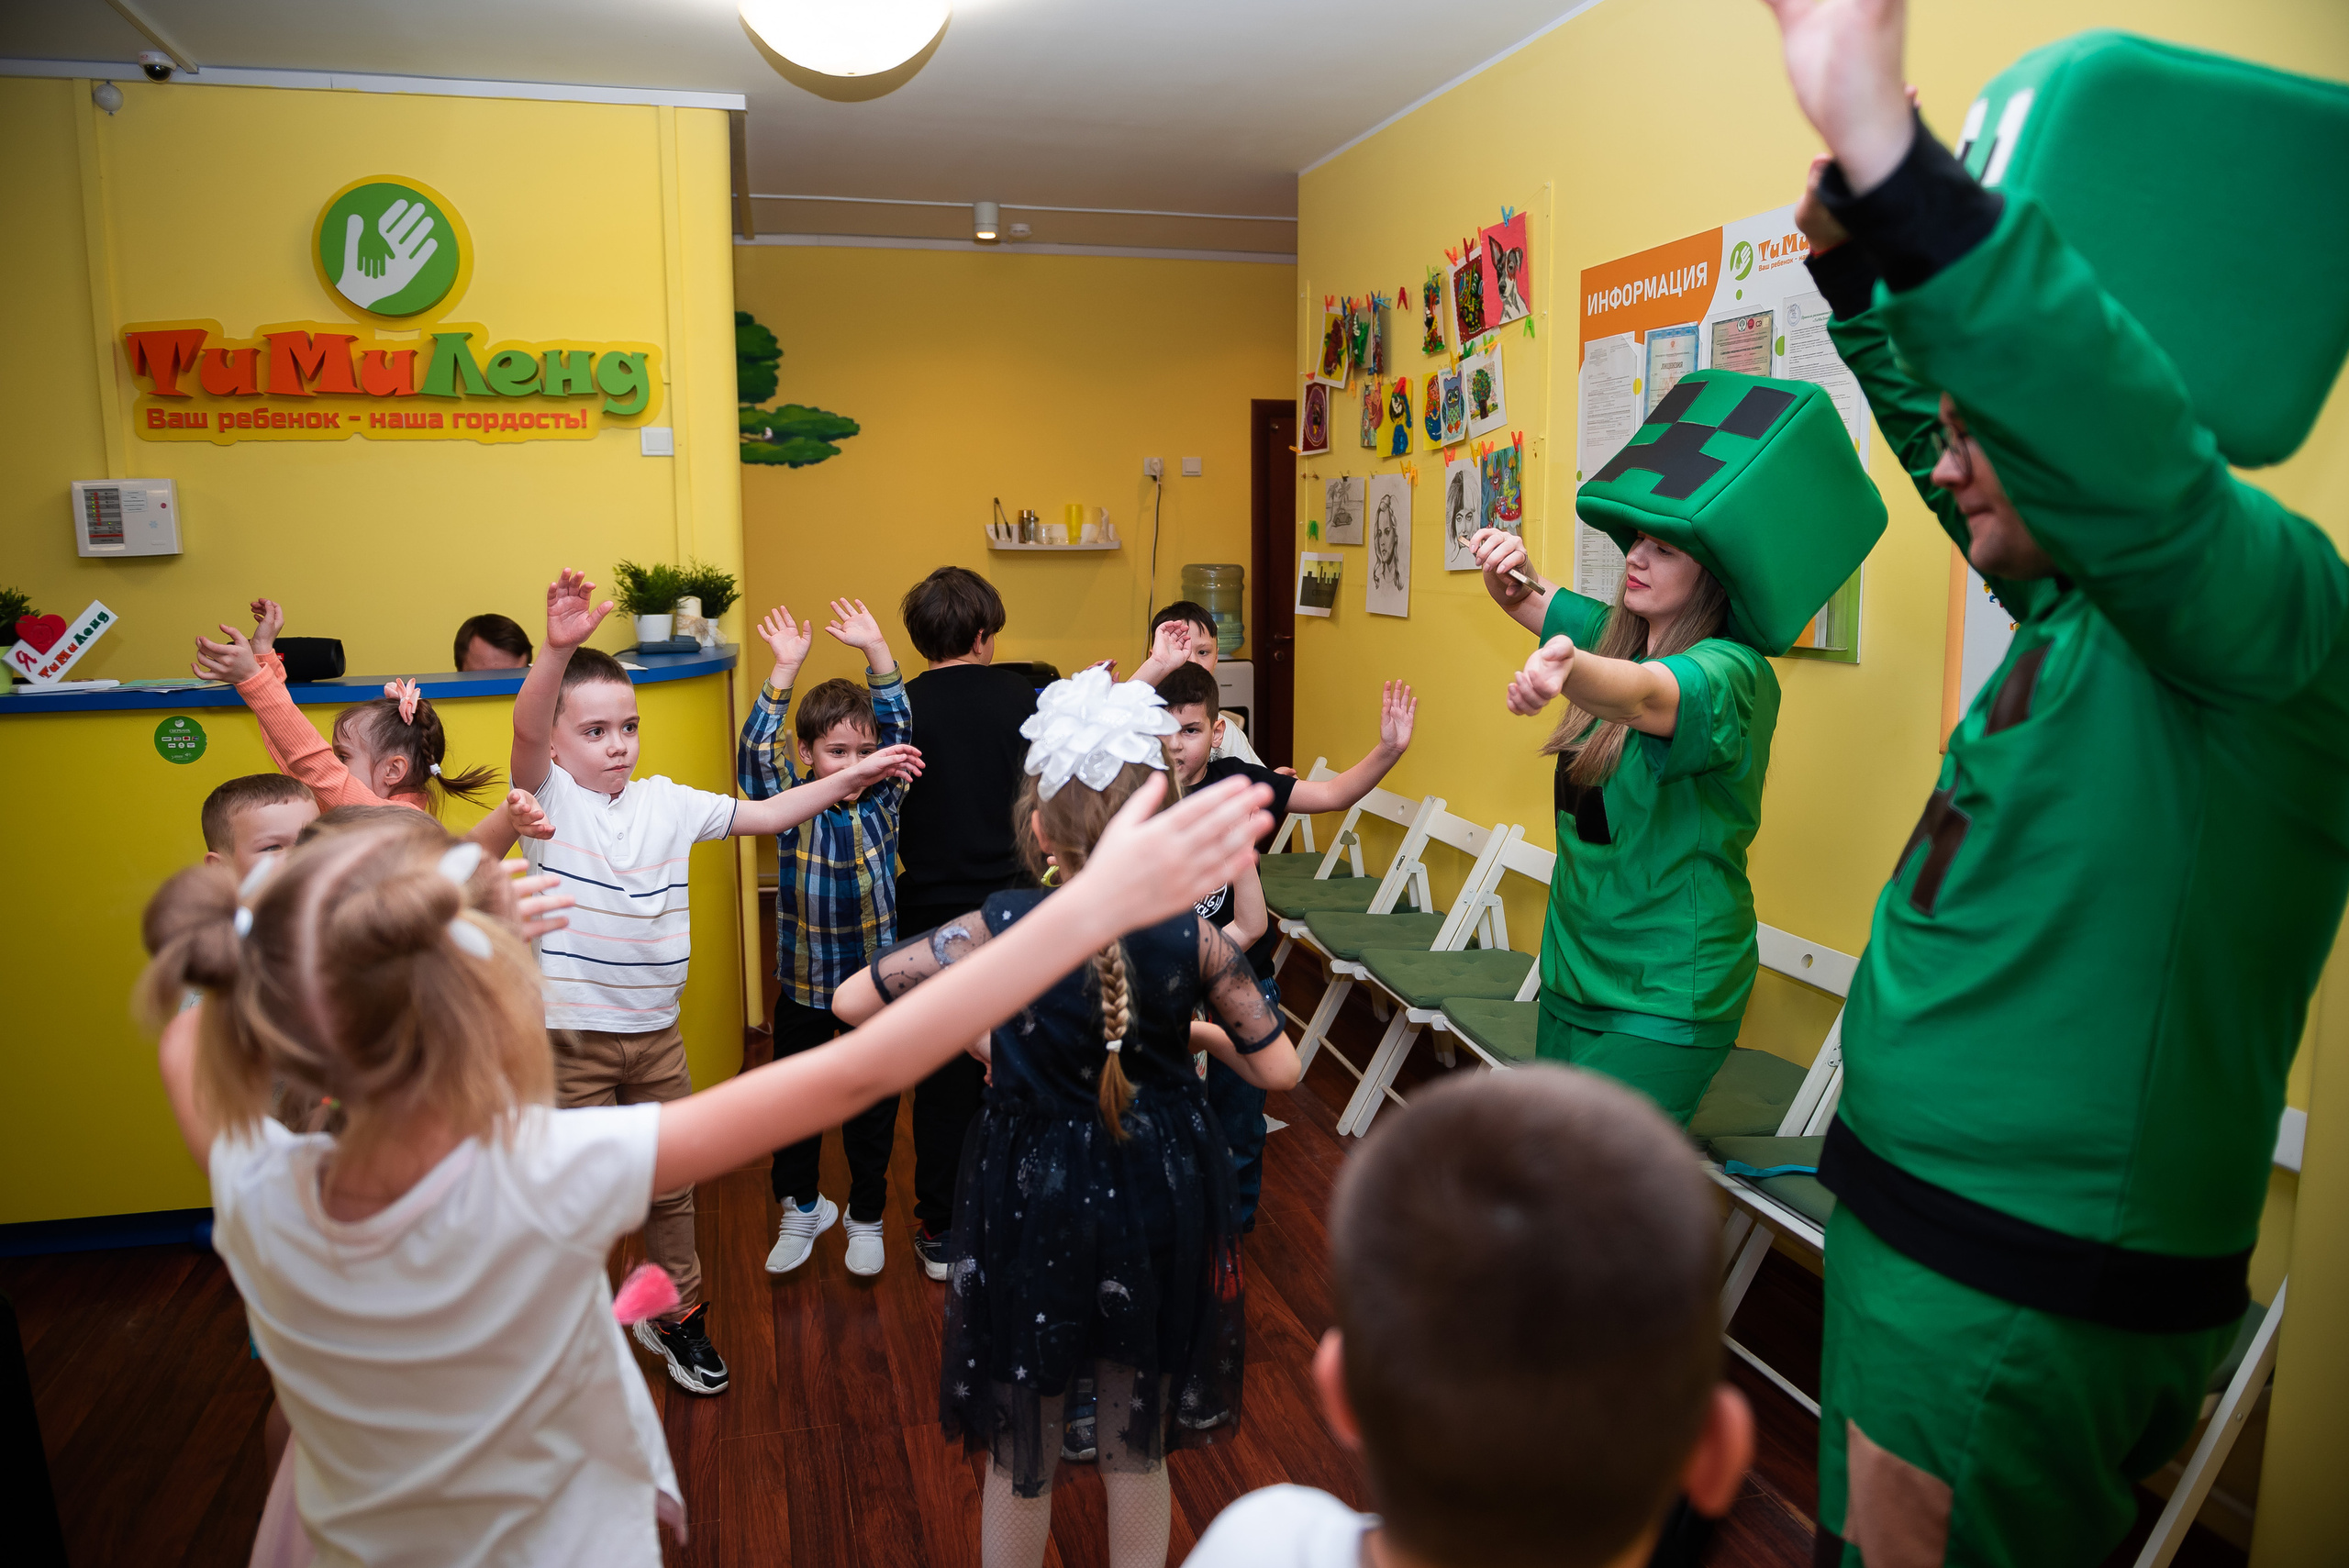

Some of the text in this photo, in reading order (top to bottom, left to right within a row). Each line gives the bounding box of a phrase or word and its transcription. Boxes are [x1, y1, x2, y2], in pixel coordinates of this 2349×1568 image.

[1758, 232, 1809, 262] ТиМи
[1758, 263, 1770, 272] Ваш
[1771, 258, 1794, 271] ребенок
[1587, 261, 1708, 317] ИНФОРМАЦИЯ
[125, 328, 651, 417] ТиМиЛенд
[146, 407, 209, 429] Ваш
[217, 407, 341, 433] ребенок
[370, 411, 444, 429] наша
[452, 407, 588, 433] гордость!
[38, 611, 110, 679] ТиМиЛенд
[15, 650, 38, 673] Я
